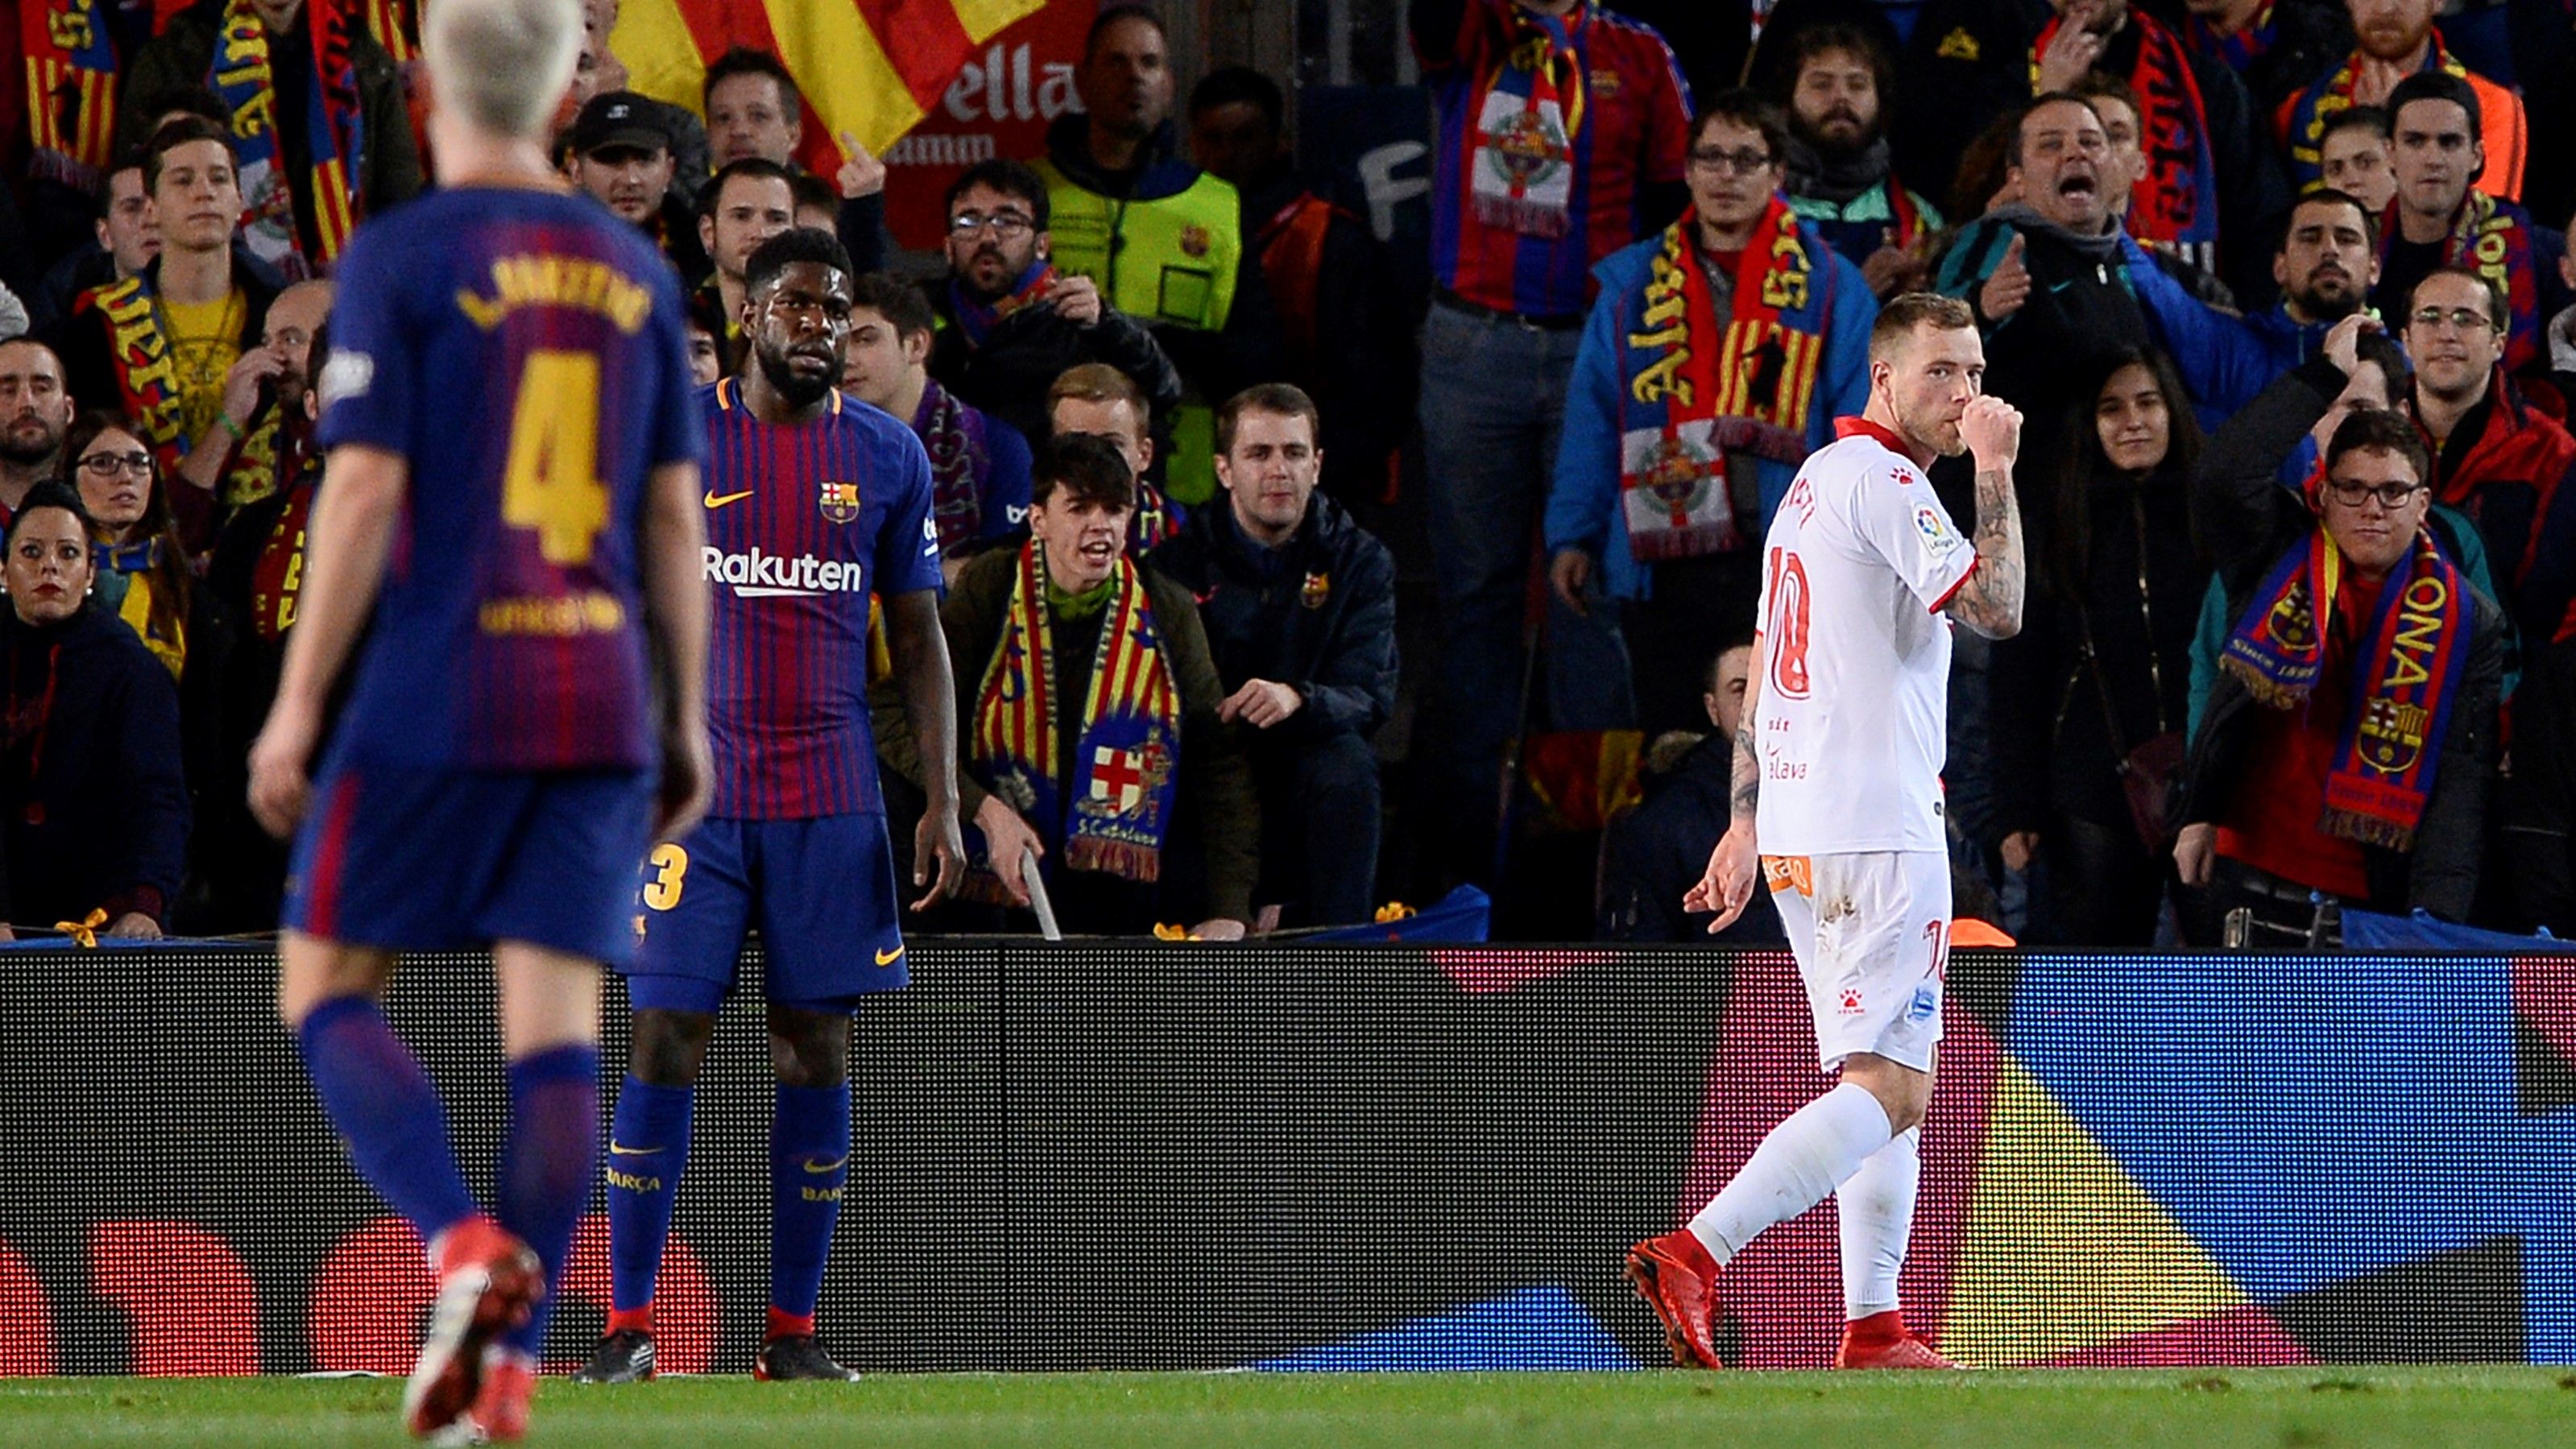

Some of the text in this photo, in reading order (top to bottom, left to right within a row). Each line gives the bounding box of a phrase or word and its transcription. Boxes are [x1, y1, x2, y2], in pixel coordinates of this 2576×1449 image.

[502, 349, 611, 562] 4
[701, 546, 862, 592] Rakuten
[1769, 545, 1812, 701] 10
